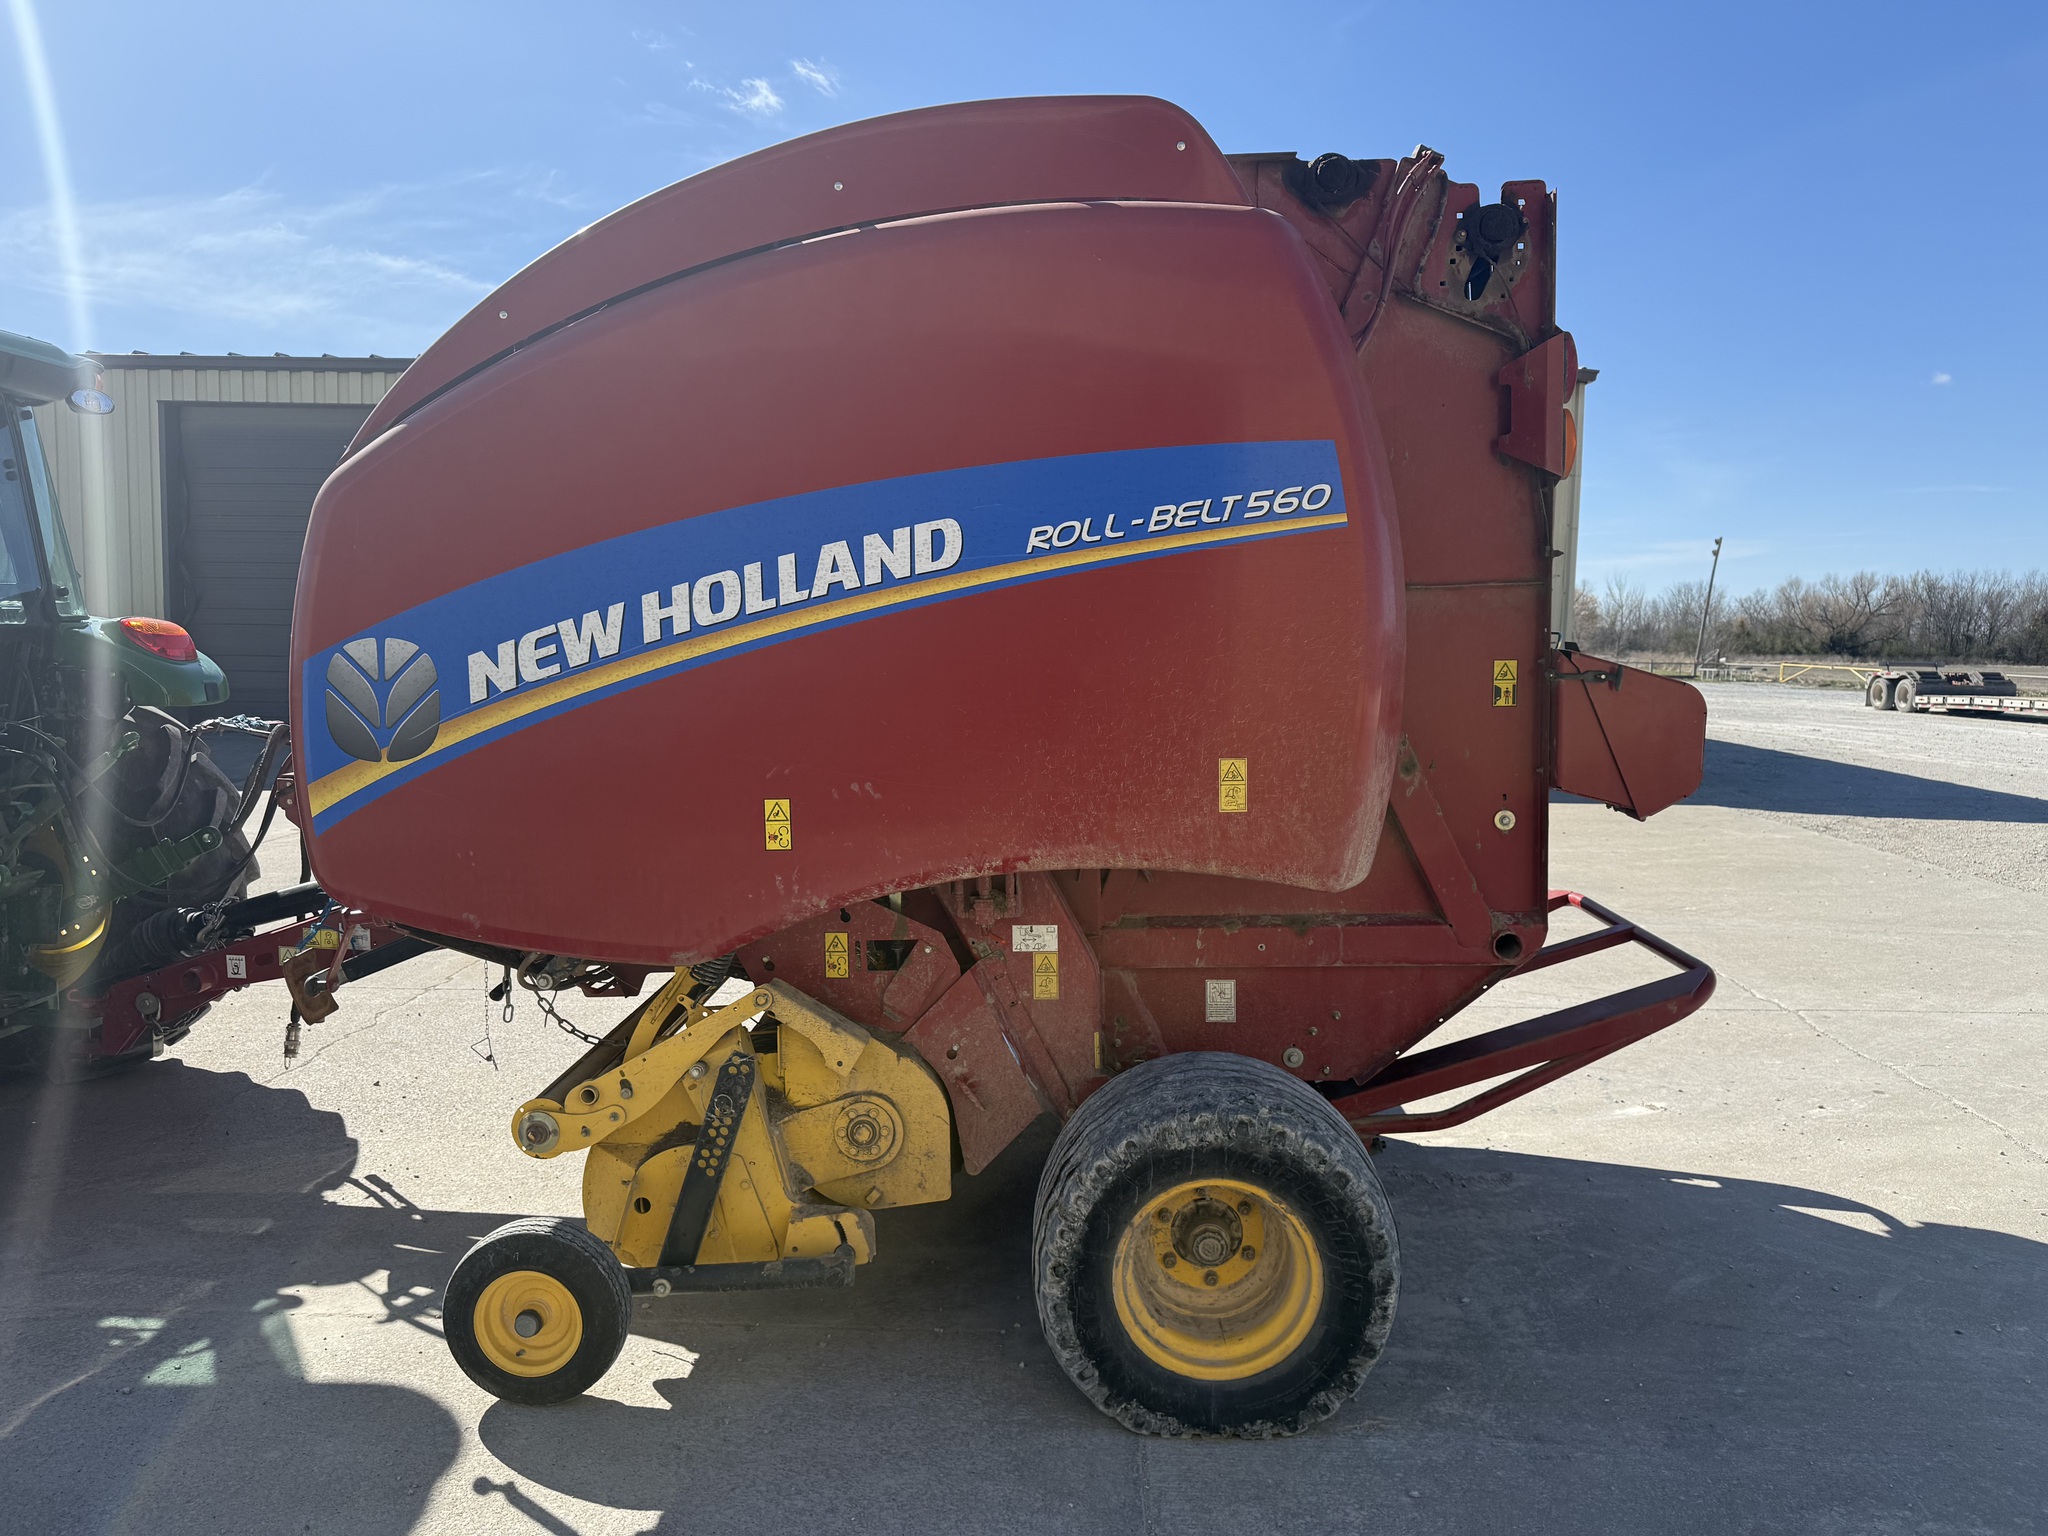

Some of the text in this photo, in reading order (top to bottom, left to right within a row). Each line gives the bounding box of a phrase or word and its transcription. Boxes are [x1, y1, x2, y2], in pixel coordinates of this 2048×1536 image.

[1243, 483, 1332, 519] 560
[467, 518, 963, 704] NEW HOLLAND
